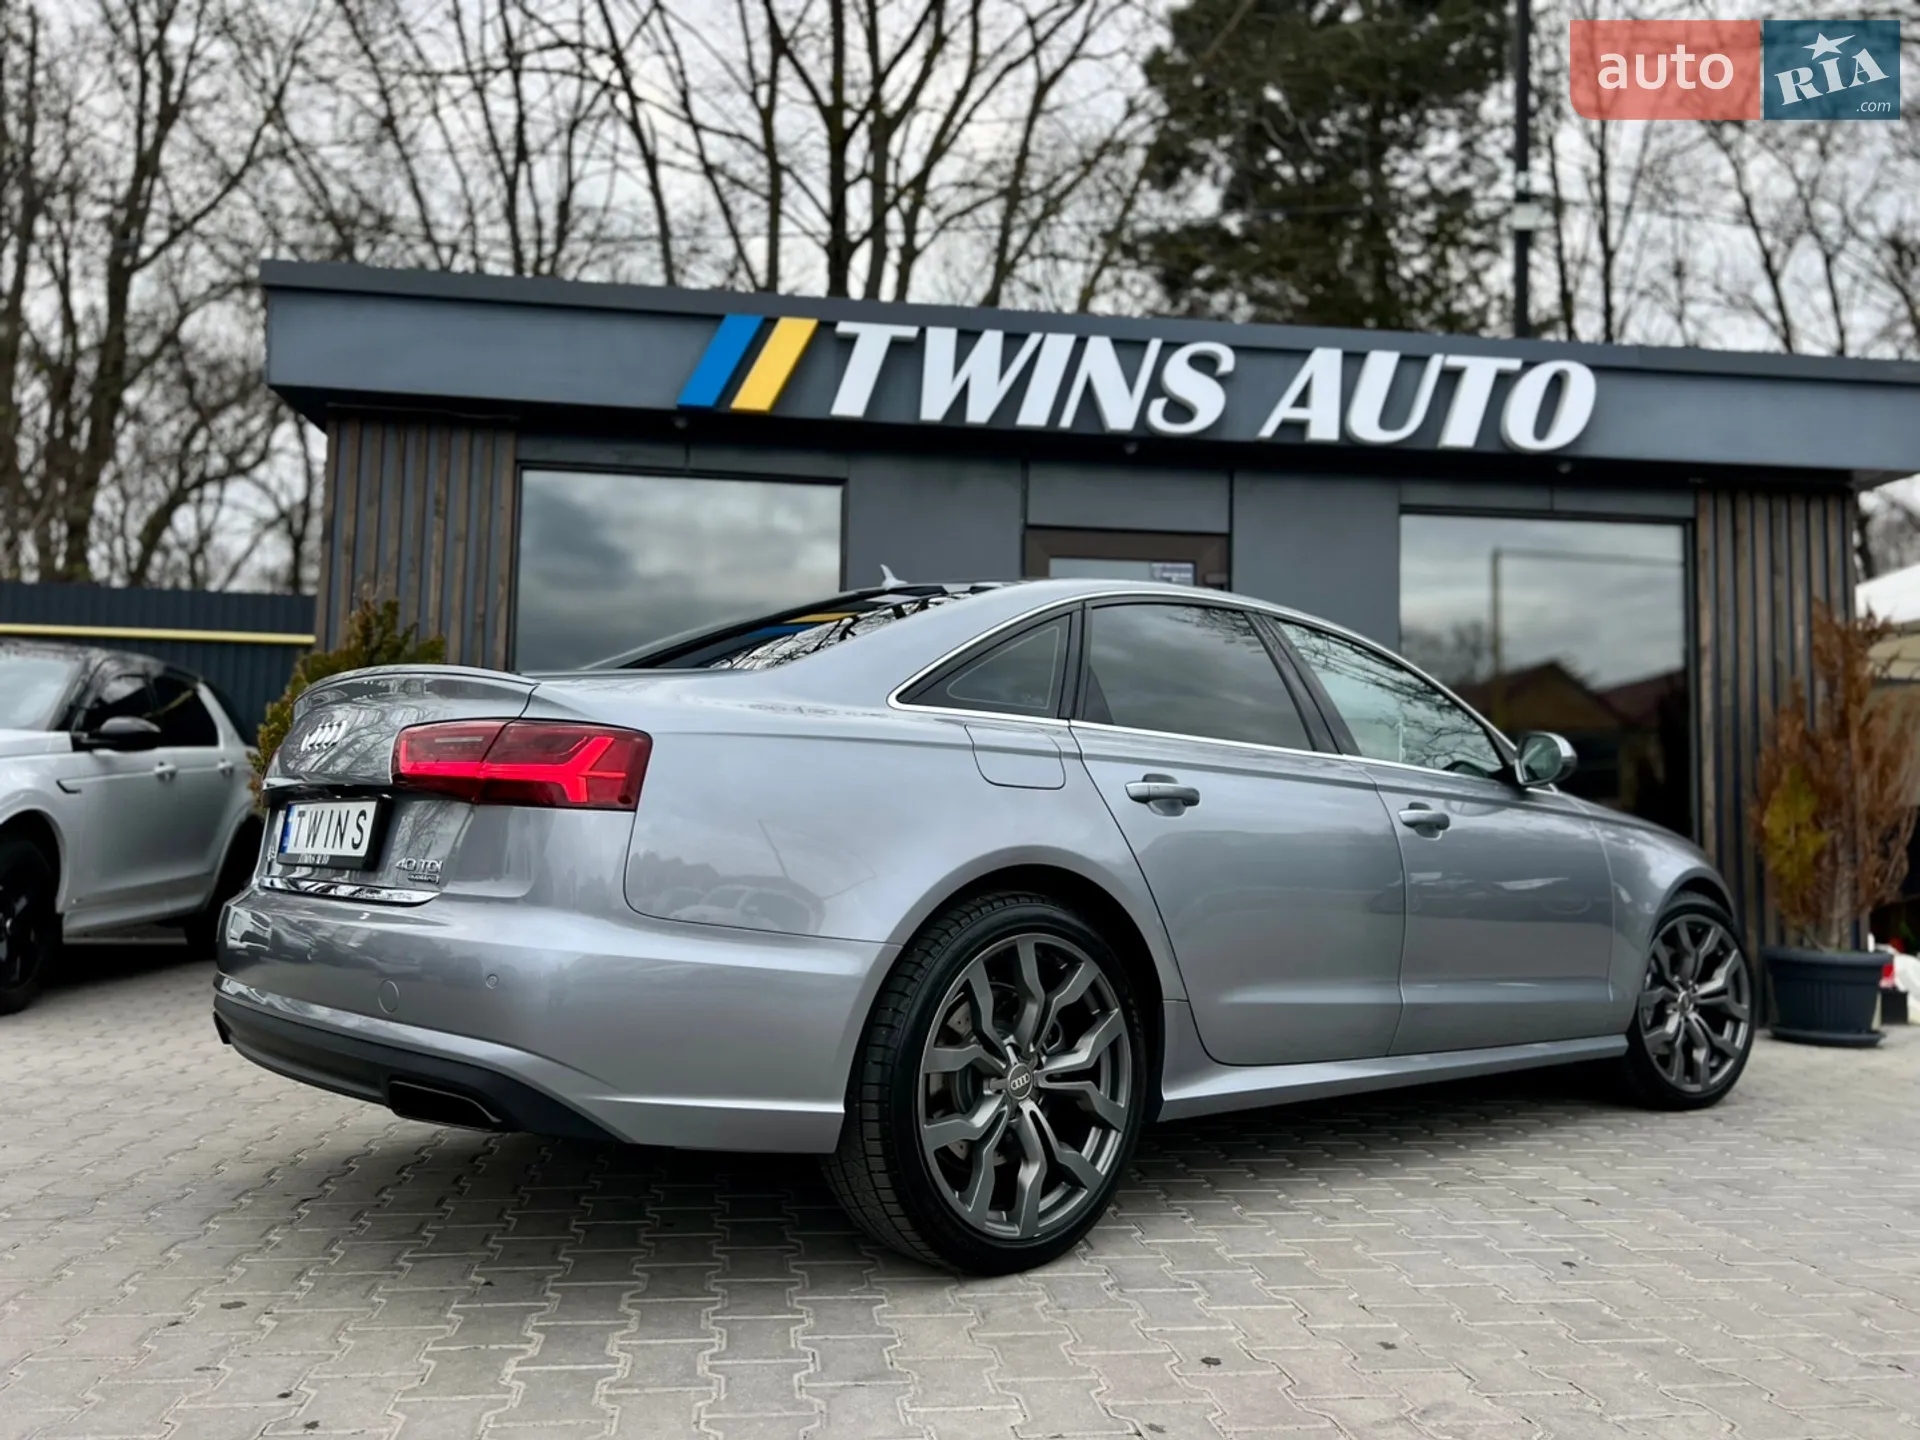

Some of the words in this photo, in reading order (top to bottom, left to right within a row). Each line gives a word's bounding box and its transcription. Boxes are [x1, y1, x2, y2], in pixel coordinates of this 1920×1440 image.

[829, 321, 1235, 437] TWINS
[1257, 347, 1598, 453] AUTO
[294, 808, 367, 850] TWINS
[395, 857, 417, 872] 40
[419, 858, 443, 873] TDI
